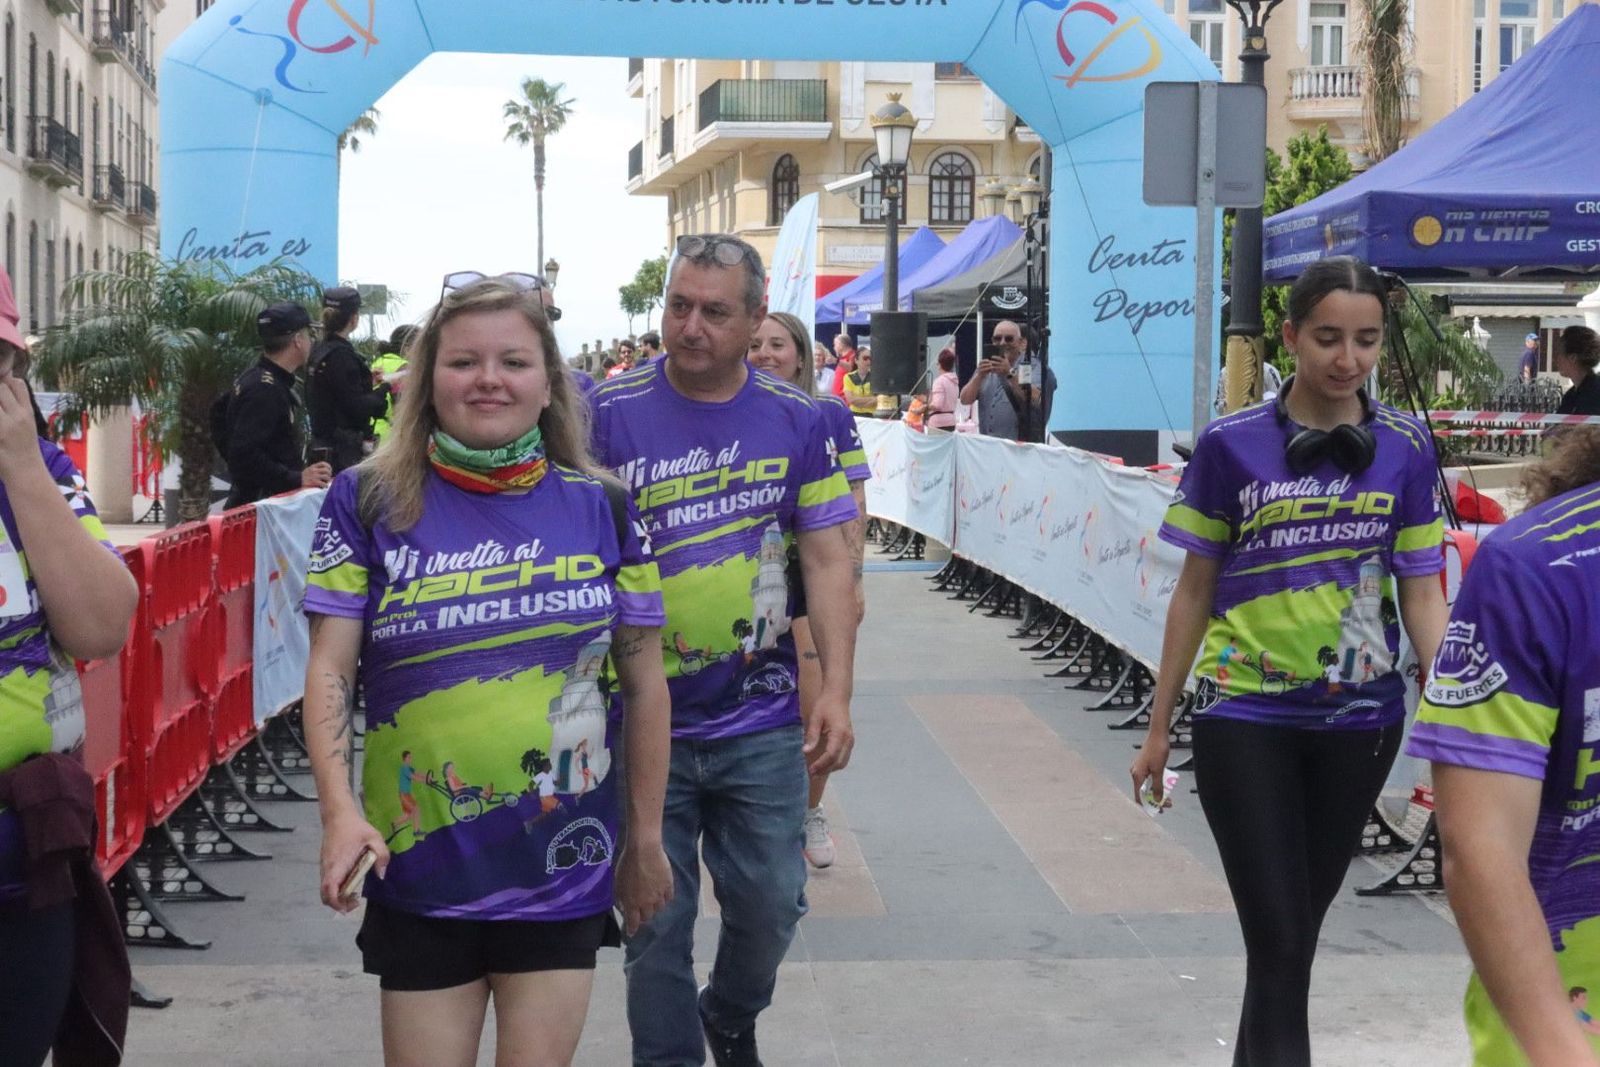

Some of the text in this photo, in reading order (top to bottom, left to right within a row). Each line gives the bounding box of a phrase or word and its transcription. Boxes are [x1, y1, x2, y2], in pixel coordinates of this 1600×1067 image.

[281, 237, 312, 257] es
[1088, 234, 1187, 273] Ceuta
[651, 446, 714, 482] vuelta
[715, 440, 741, 468] al
[667, 483, 786, 528] INCLUSIÓN
[1262, 475, 1326, 503] vuelta
[1325, 473, 1352, 496] al
[425, 538, 512, 576] vuelta
[513, 538, 545, 562] al
[372, 582, 612, 642] POR LA INCLUSIÓN
[1446, 669, 1503, 700] FUERTES
